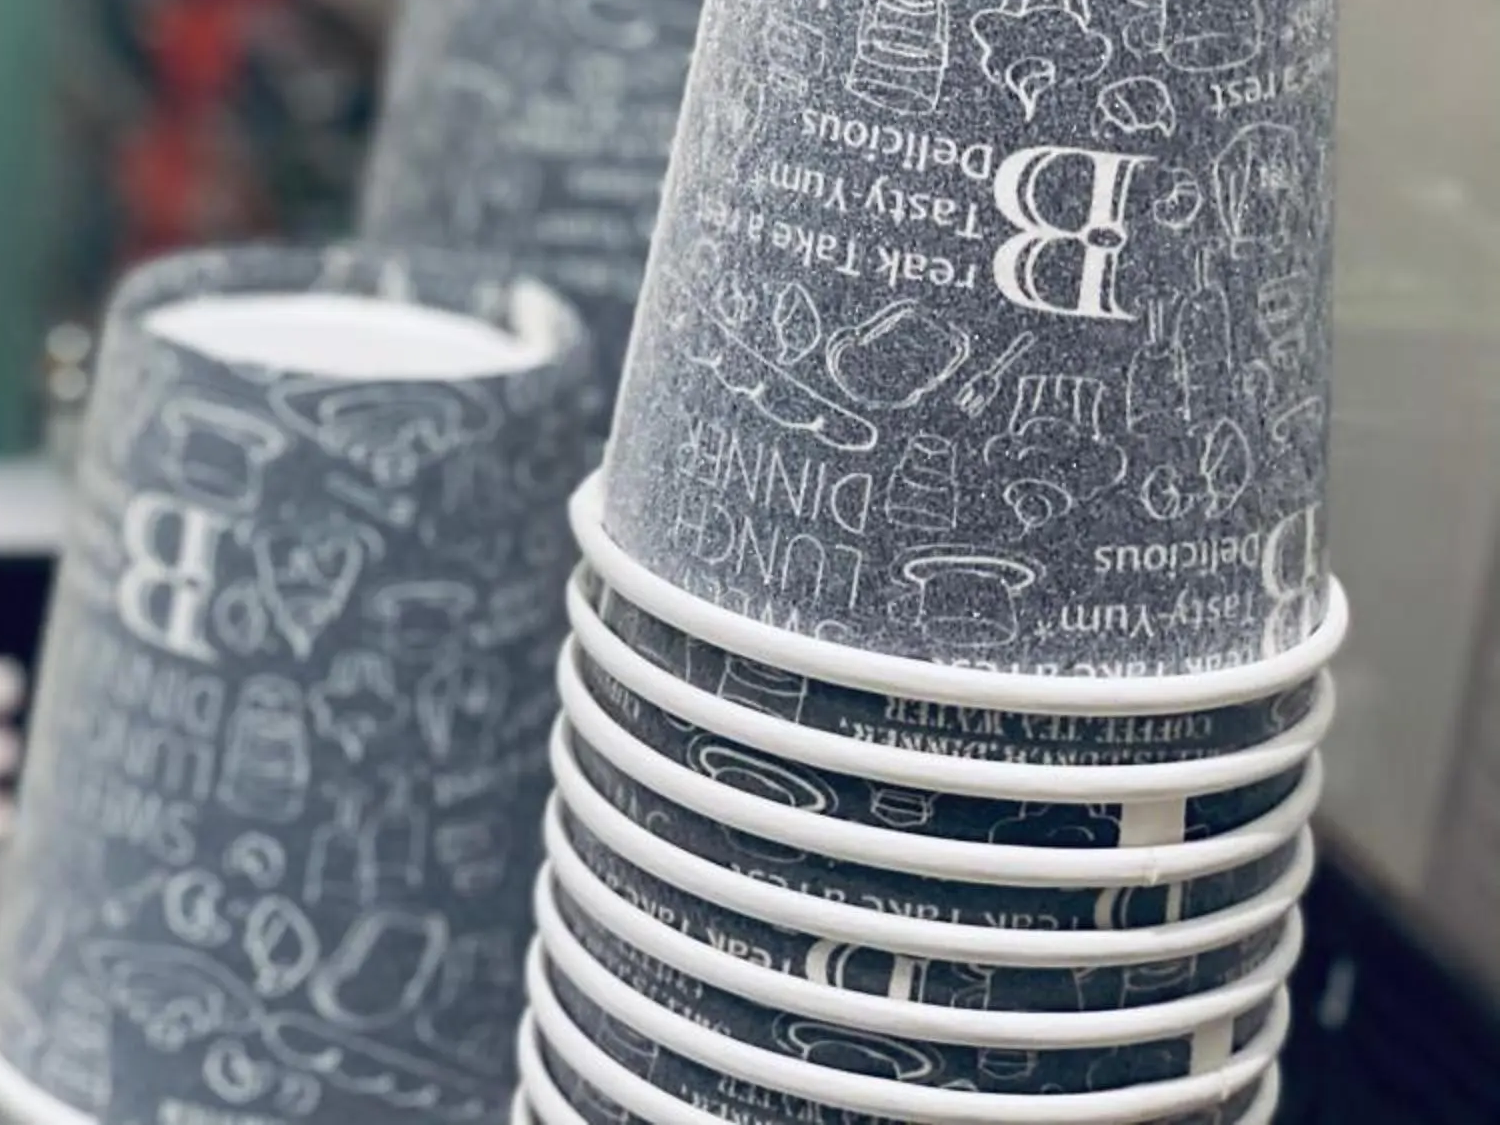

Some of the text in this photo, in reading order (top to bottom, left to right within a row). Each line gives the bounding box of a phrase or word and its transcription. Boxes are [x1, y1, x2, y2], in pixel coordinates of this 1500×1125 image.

[1210, 71, 1276, 119] rest
[800, 108, 994, 180] Delicious
[772, 219, 862, 278] Take
[874, 246, 978, 291] reak
[674, 489, 863, 610] LUNCH
[1094, 532, 1260, 576] Delicious
